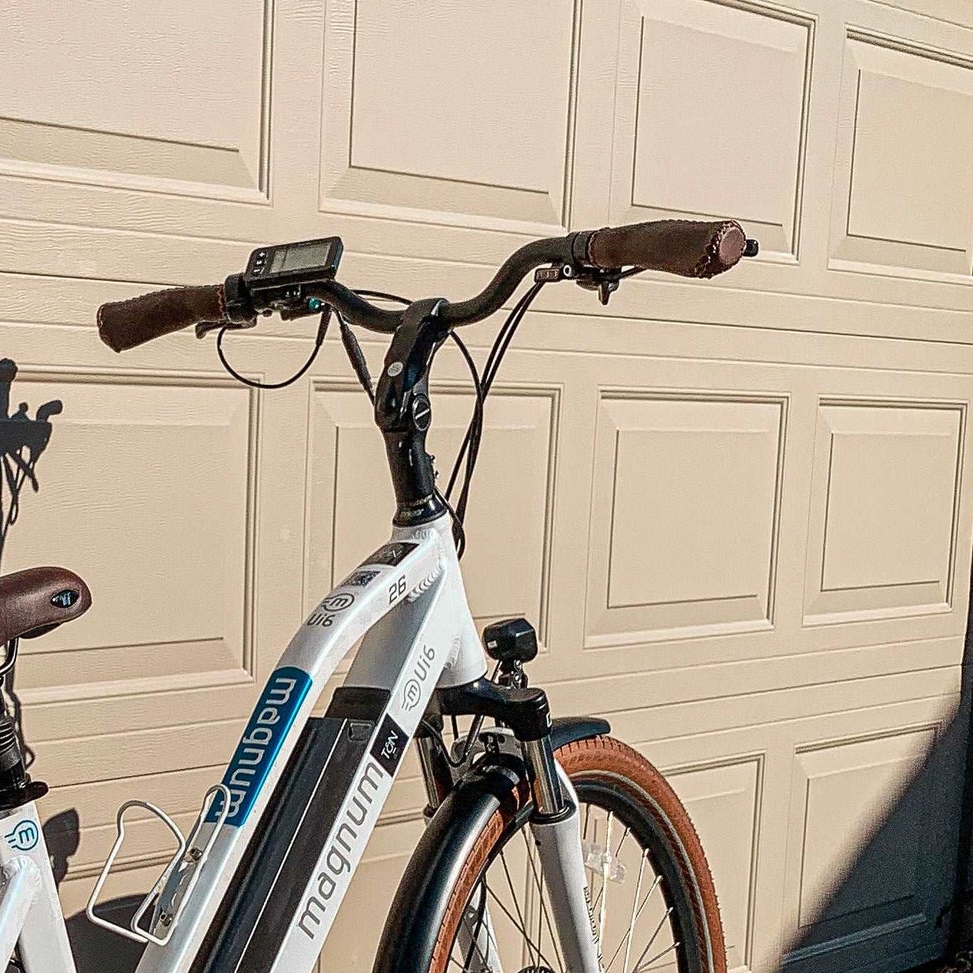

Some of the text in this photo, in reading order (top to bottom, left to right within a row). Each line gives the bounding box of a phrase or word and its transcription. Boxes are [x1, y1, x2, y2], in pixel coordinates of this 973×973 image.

[388, 574, 407, 605] 26
[307, 613, 335, 627] Ui6
[414, 645, 437, 684] Ui6
[217, 677, 297, 819] magnum
[297, 760, 385, 940] magnum
